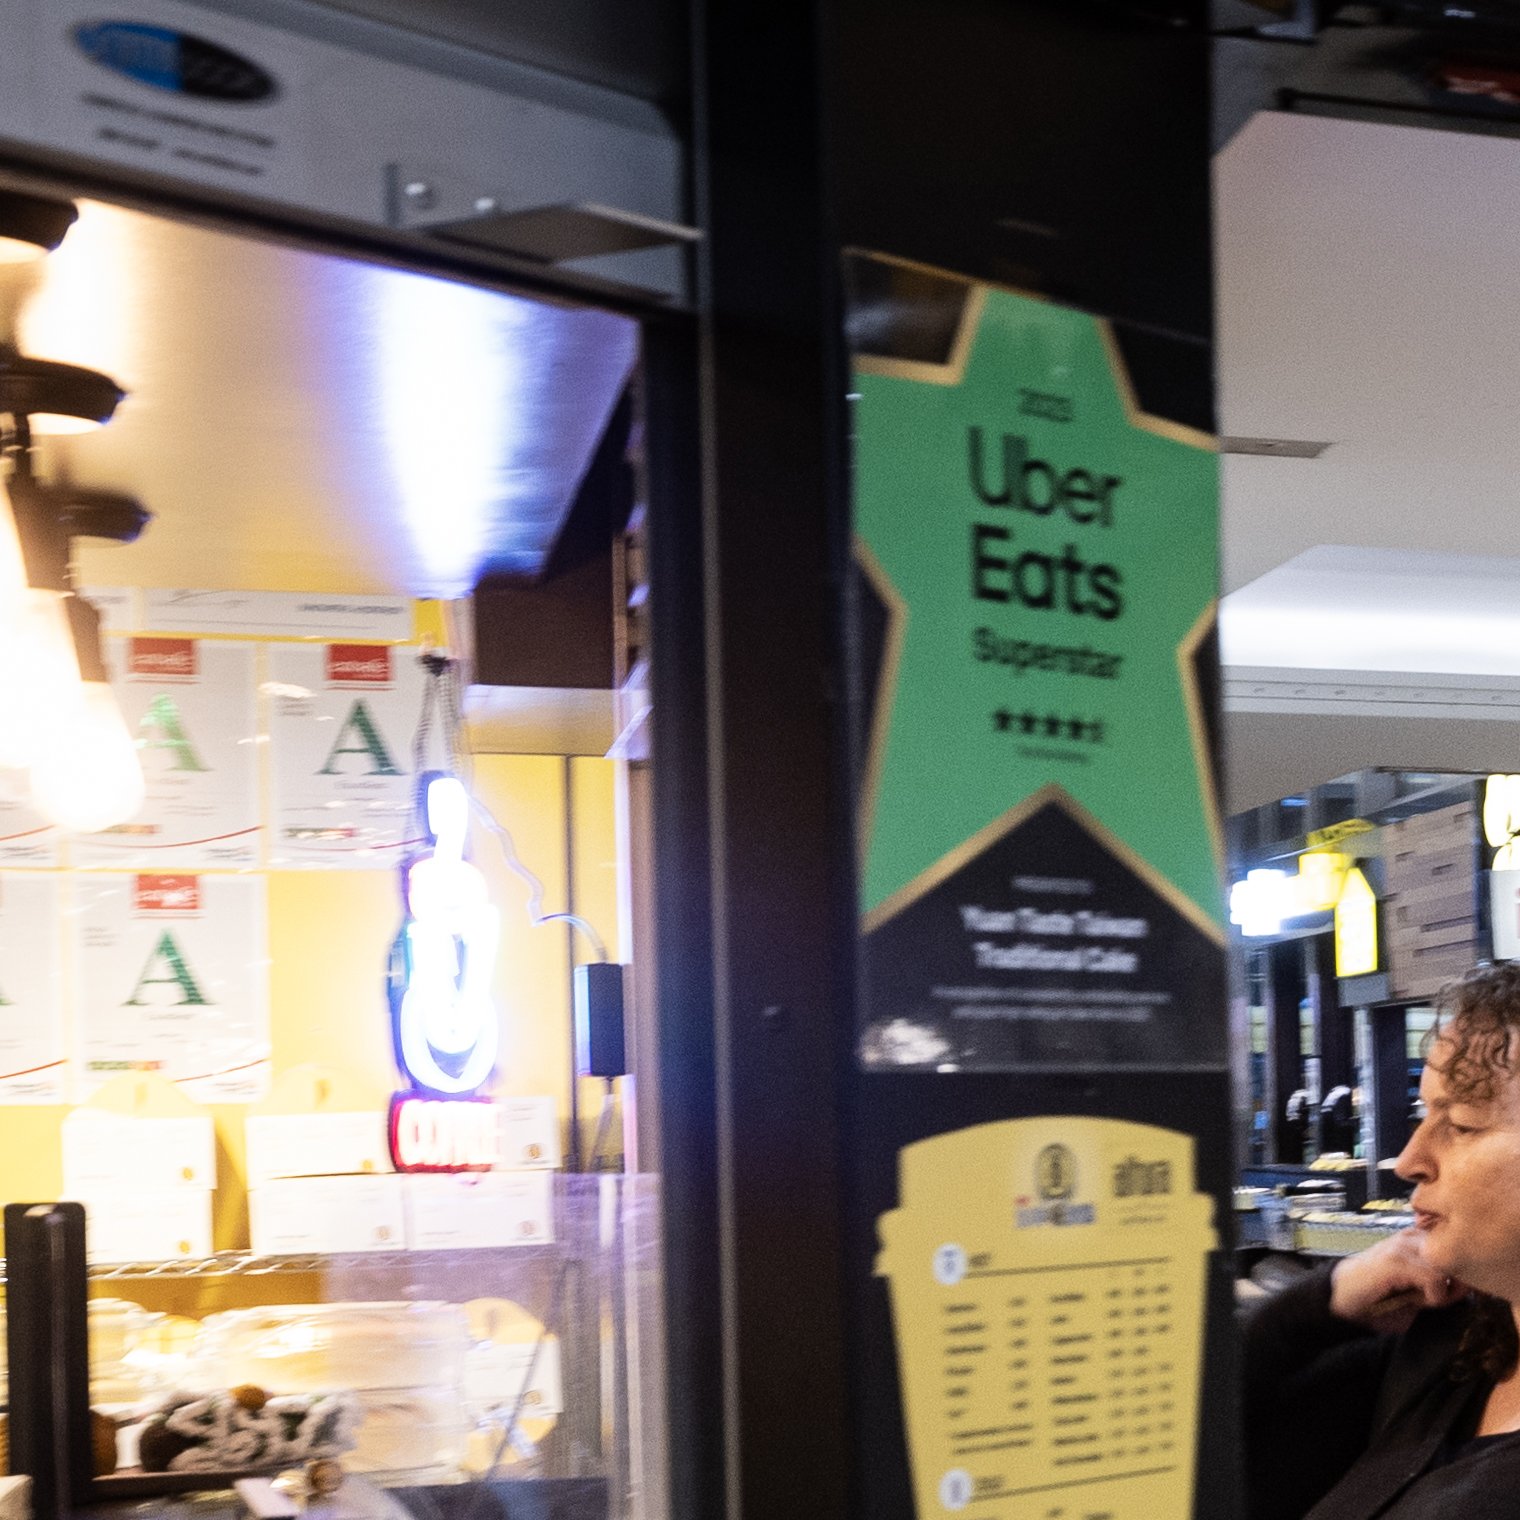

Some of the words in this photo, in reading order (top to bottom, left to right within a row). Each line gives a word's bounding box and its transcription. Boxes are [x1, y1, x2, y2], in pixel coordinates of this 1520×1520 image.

[968, 427, 1122, 527] Uber
[971, 525, 1122, 621] Eats
[312, 698, 407, 775] A
[122, 928, 214, 1007] A
